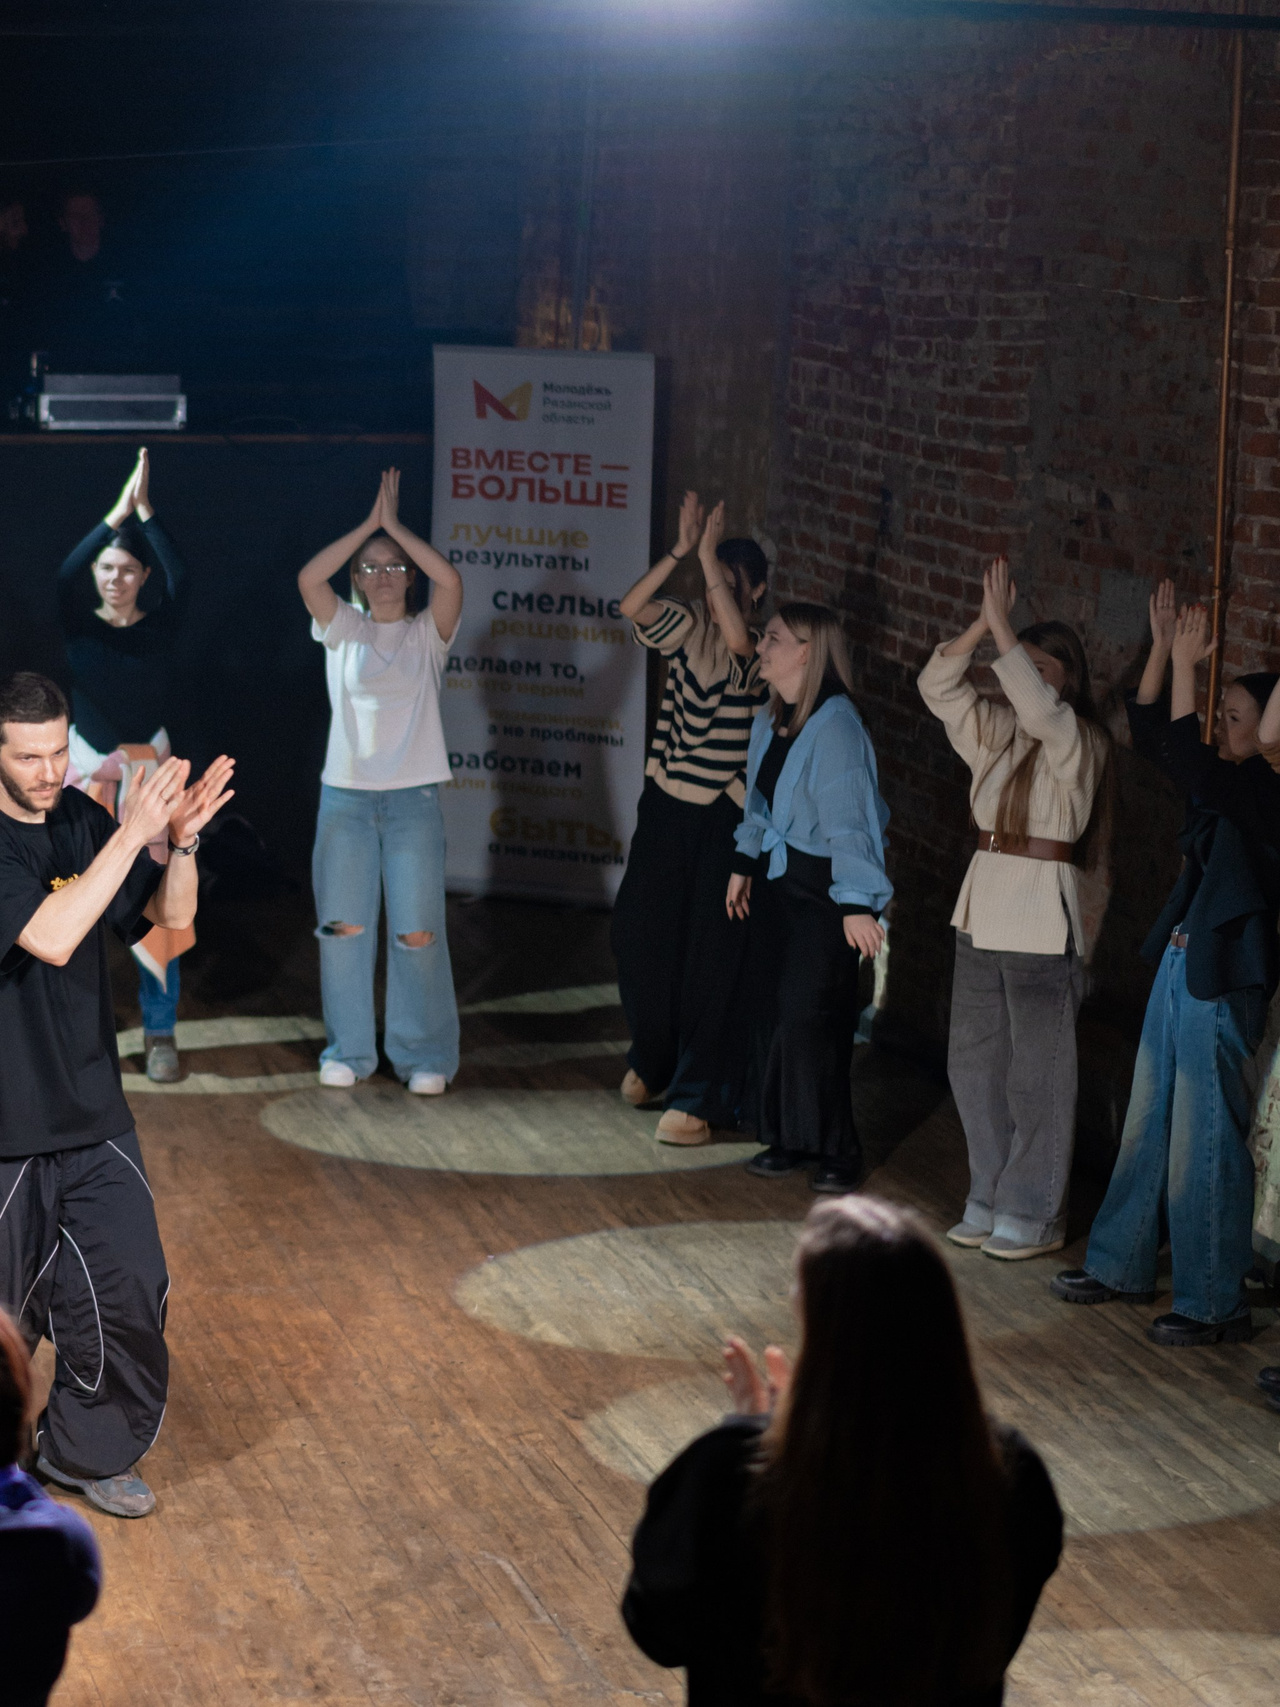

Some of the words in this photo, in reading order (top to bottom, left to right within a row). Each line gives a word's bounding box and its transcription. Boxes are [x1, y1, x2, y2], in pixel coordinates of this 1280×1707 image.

[543, 382, 612, 396] Молодёжь
[542, 397, 612, 412] Рязанской
[542, 412, 595, 425] области
[450, 447, 592, 476] ВМЕСТЕ
[450, 474, 628, 510] БОЛЬШЕ
[449, 523, 589, 549] лучшие
[448, 549, 590, 572] результаты
[492, 590, 624, 620] смелые
[490, 617, 626, 645] решения
[446, 655, 541, 677] делаем
[550, 662, 585, 684] то,
[530, 727, 624, 747] проблемы
[448, 750, 582, 779] работаем
